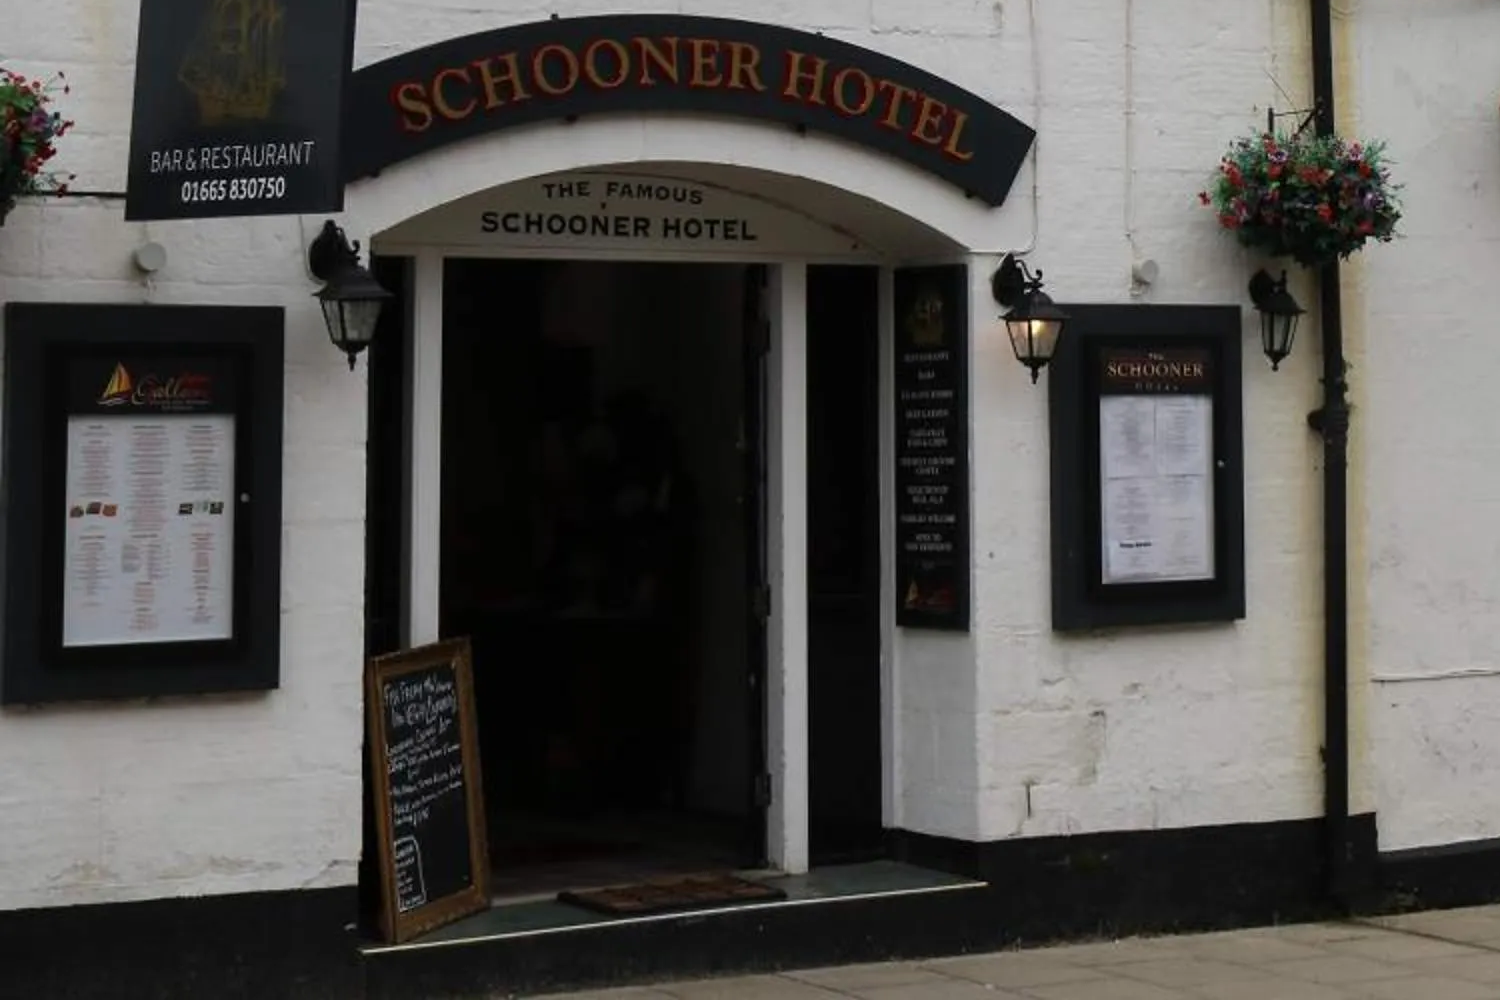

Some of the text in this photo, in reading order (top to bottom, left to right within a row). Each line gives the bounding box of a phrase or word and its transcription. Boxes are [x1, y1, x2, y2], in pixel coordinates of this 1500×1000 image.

[393, 37, 975, 161] SCHOONER HOTEL
[150, 141, 315, 173] BAR & RESTAURANT
[181, 177, 286, 203] 01665 830750
[542, 181, 705, 205] THE FAMOUS
[480, 211, 759, 241] SCHOONER HOTEL
[1107, 361, 1204, 379] SCHOONER
